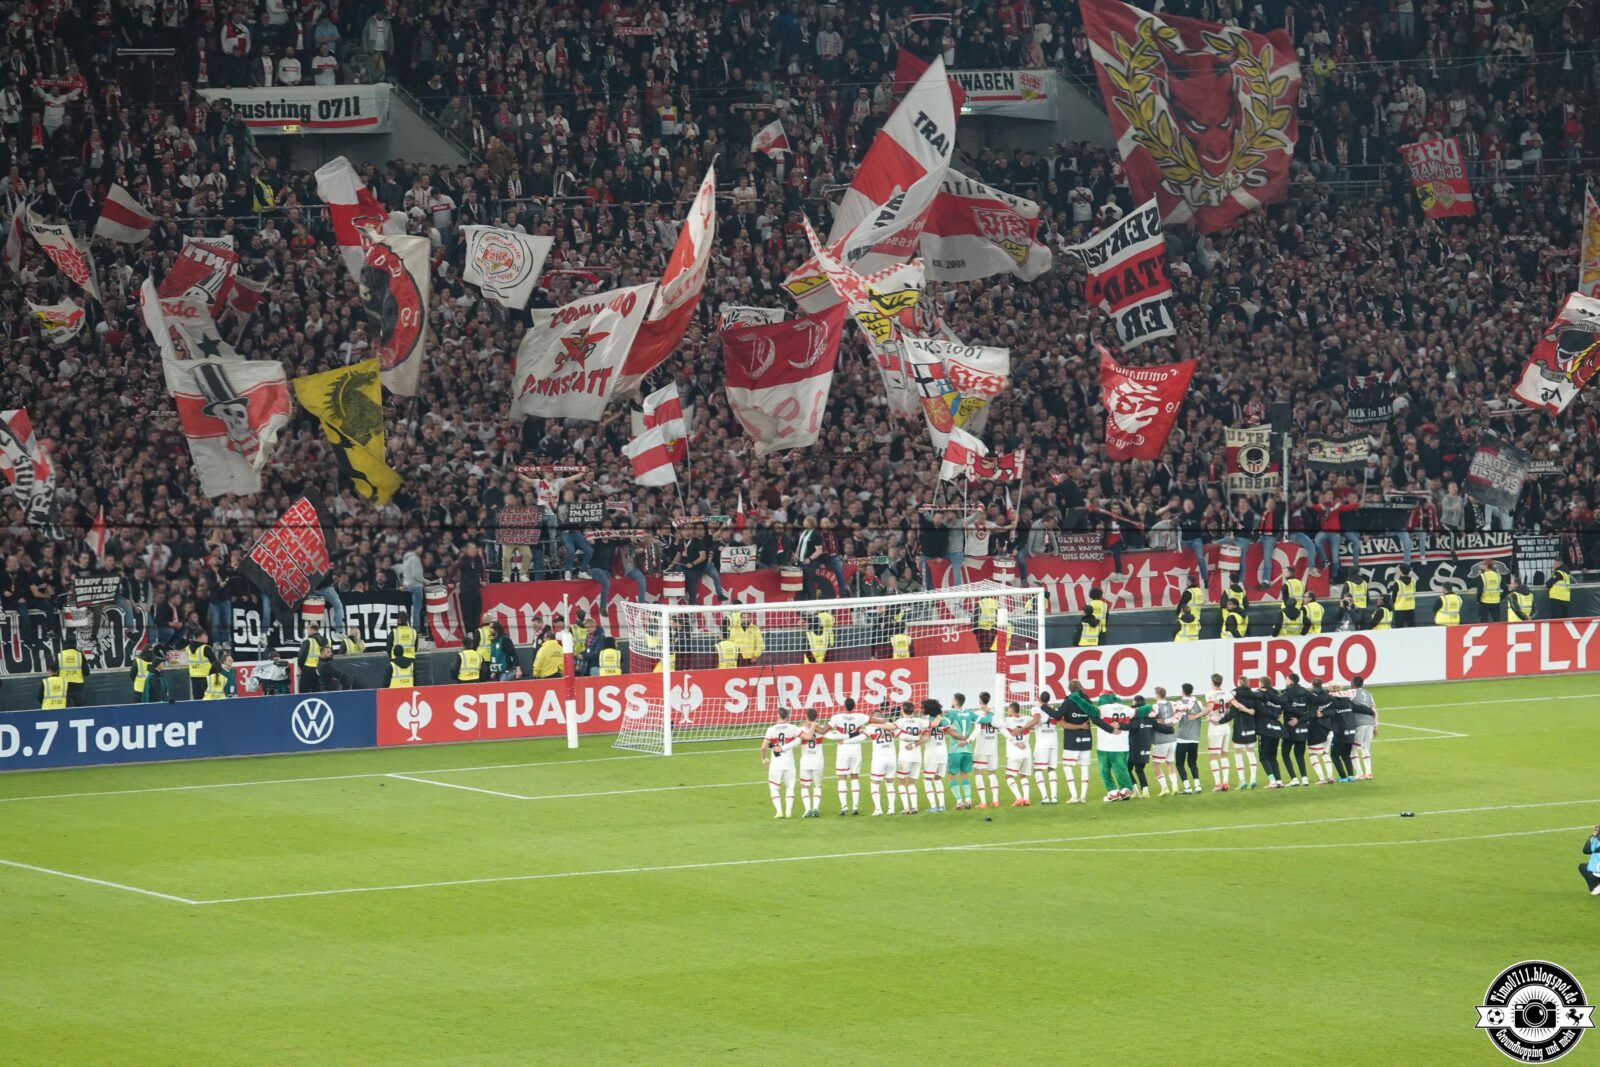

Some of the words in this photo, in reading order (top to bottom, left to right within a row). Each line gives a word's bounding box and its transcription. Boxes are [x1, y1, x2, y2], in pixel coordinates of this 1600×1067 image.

[318, 96, 360, 119] 0711
[941, 626, 960, 643] 35
[1506, 619, 1600, 674] FLY
[1232, 633, 1377, 688] ERGO
[723, 667, 913, 713] STRAUSS
[1004, 646, 1149, 708] ERGO
[453, 683, 649, 732] STRAUSS
[1218, 698, 1225, 714] 3
[69, 718, 204, 753] Tourer
[875, 728, 892, 745] 26
[930, 728, 944, 741] 45
[962, 719, 967, 737] 1
